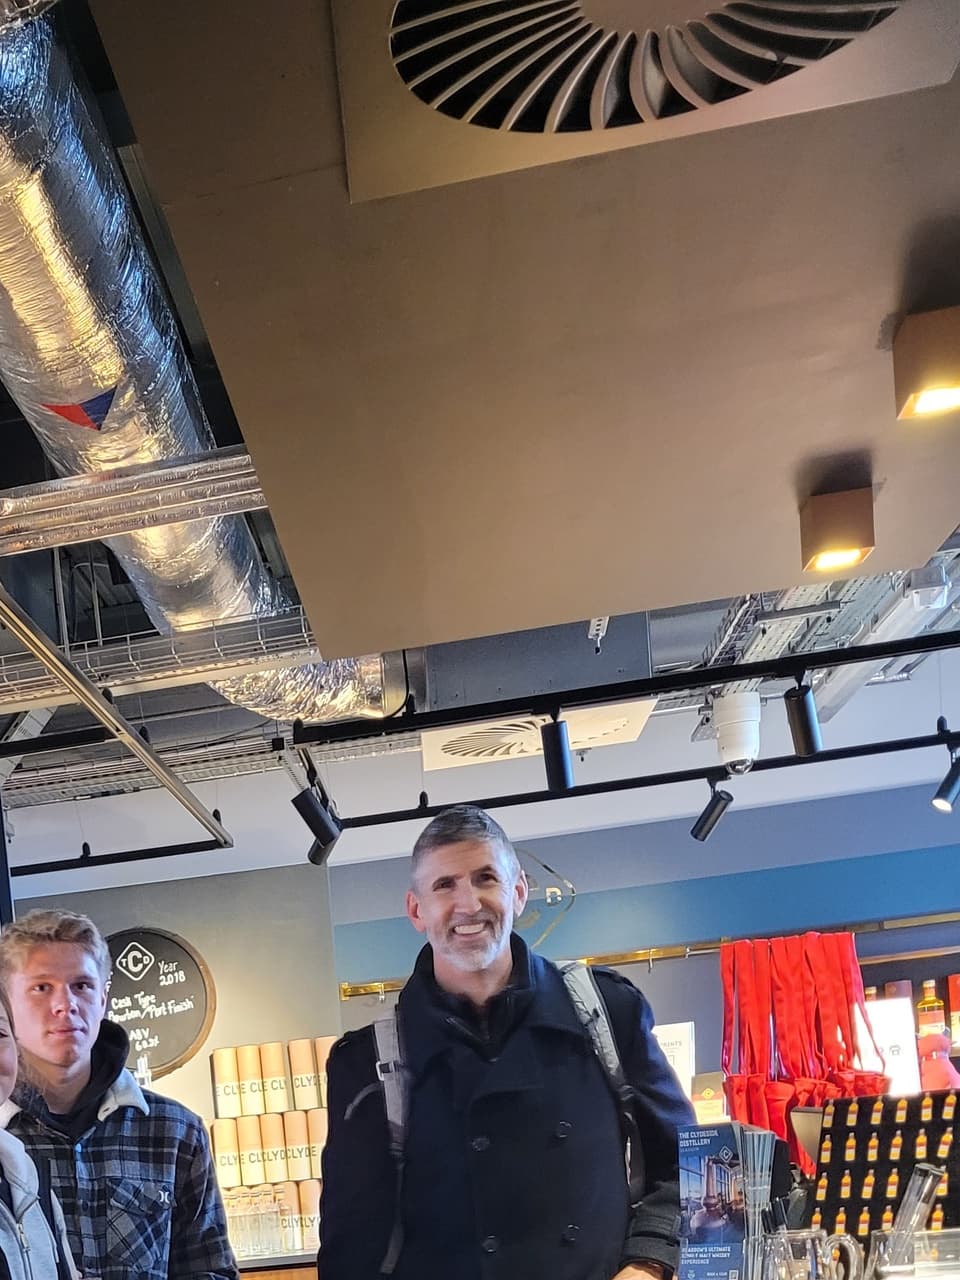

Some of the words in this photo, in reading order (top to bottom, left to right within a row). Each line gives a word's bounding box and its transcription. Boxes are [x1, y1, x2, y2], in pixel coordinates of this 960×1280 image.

[158, 960, 178, 974] Year
[159, 970, 186, 986] 2018
[111, 996, 132, 1010] Cask
[134, 991, 156, 1009] Type
[679, 1131, 689, 1139] THE
[680, 1138, 711, 1147] DISTILLERY
